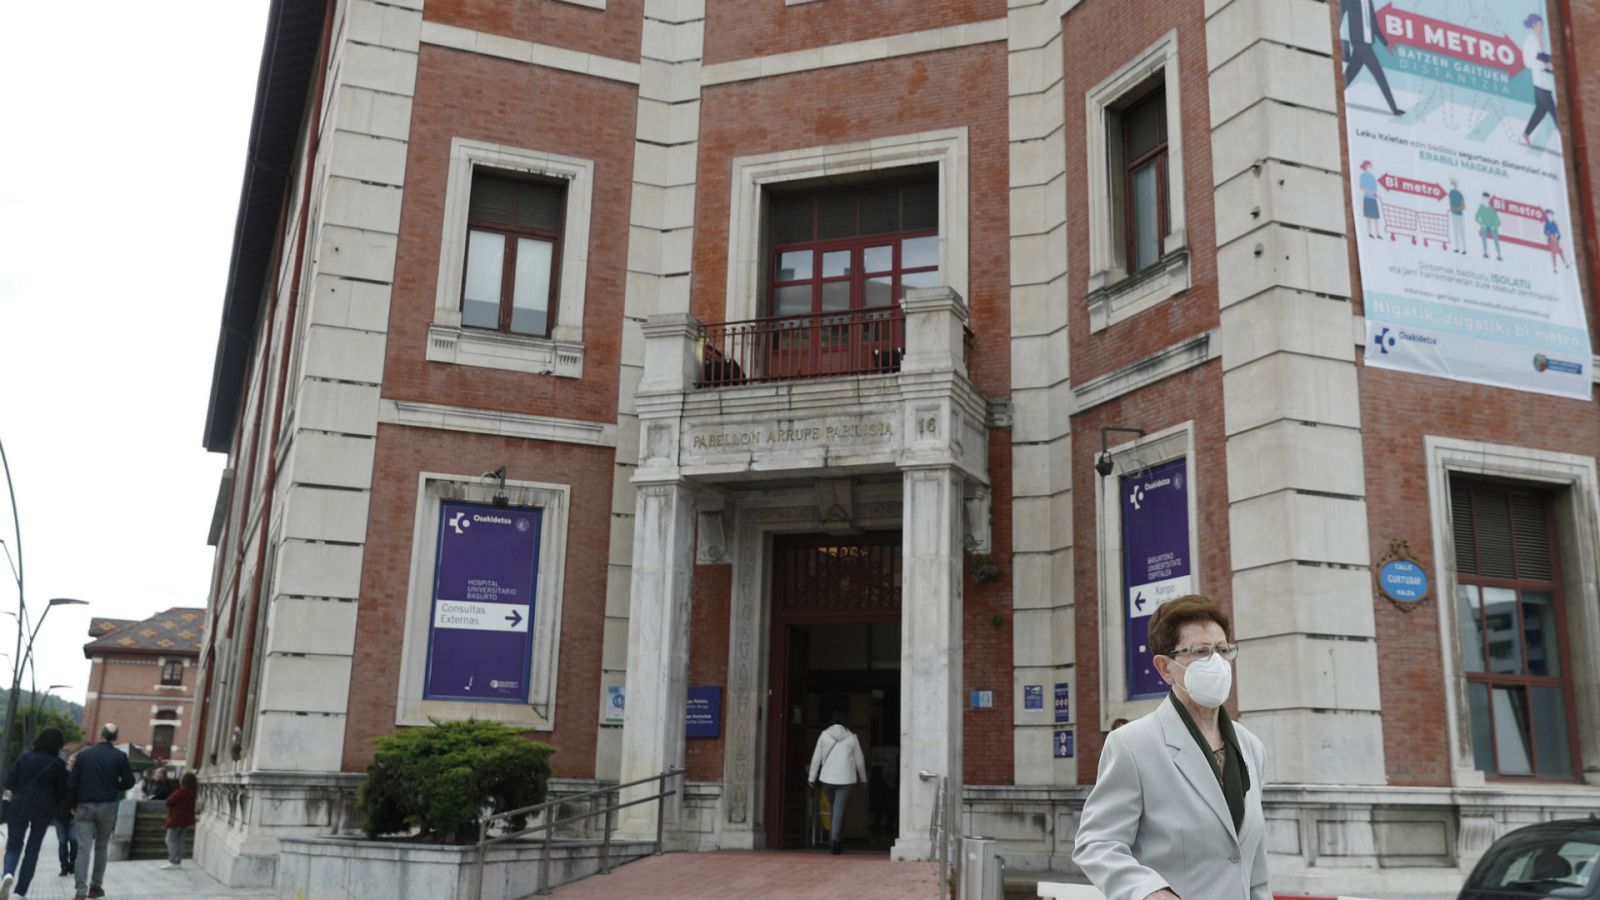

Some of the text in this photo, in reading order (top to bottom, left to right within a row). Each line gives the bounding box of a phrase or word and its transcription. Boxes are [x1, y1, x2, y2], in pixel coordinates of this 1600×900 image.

[1385, 14, 1515, 65] BI METRO
[1398, 47, 1509, 83] BATZEN GAITUEN
[1419, 151, 1508, 177] ERABILI MASKARA
[1385, 177, 1441, 196] Bi metro
[1493, 199, 1543, 218] Bi metro
[1514, 322, 1529, 337] bi
[1399, 331, 1437, 344] Osakidetza
[693, 432, 760, 448] PABELLON
[766, 428, 819, 442] ARRUPE
[473, 514, 512, 524] Osakidetza
[467, 579, 498, 587] HOSPITAL
[467, 586, 517, 596] UNIVERSITARIO
[441, 603, 486, 614] Consultas
[440, 614, 480, 625] Externas
